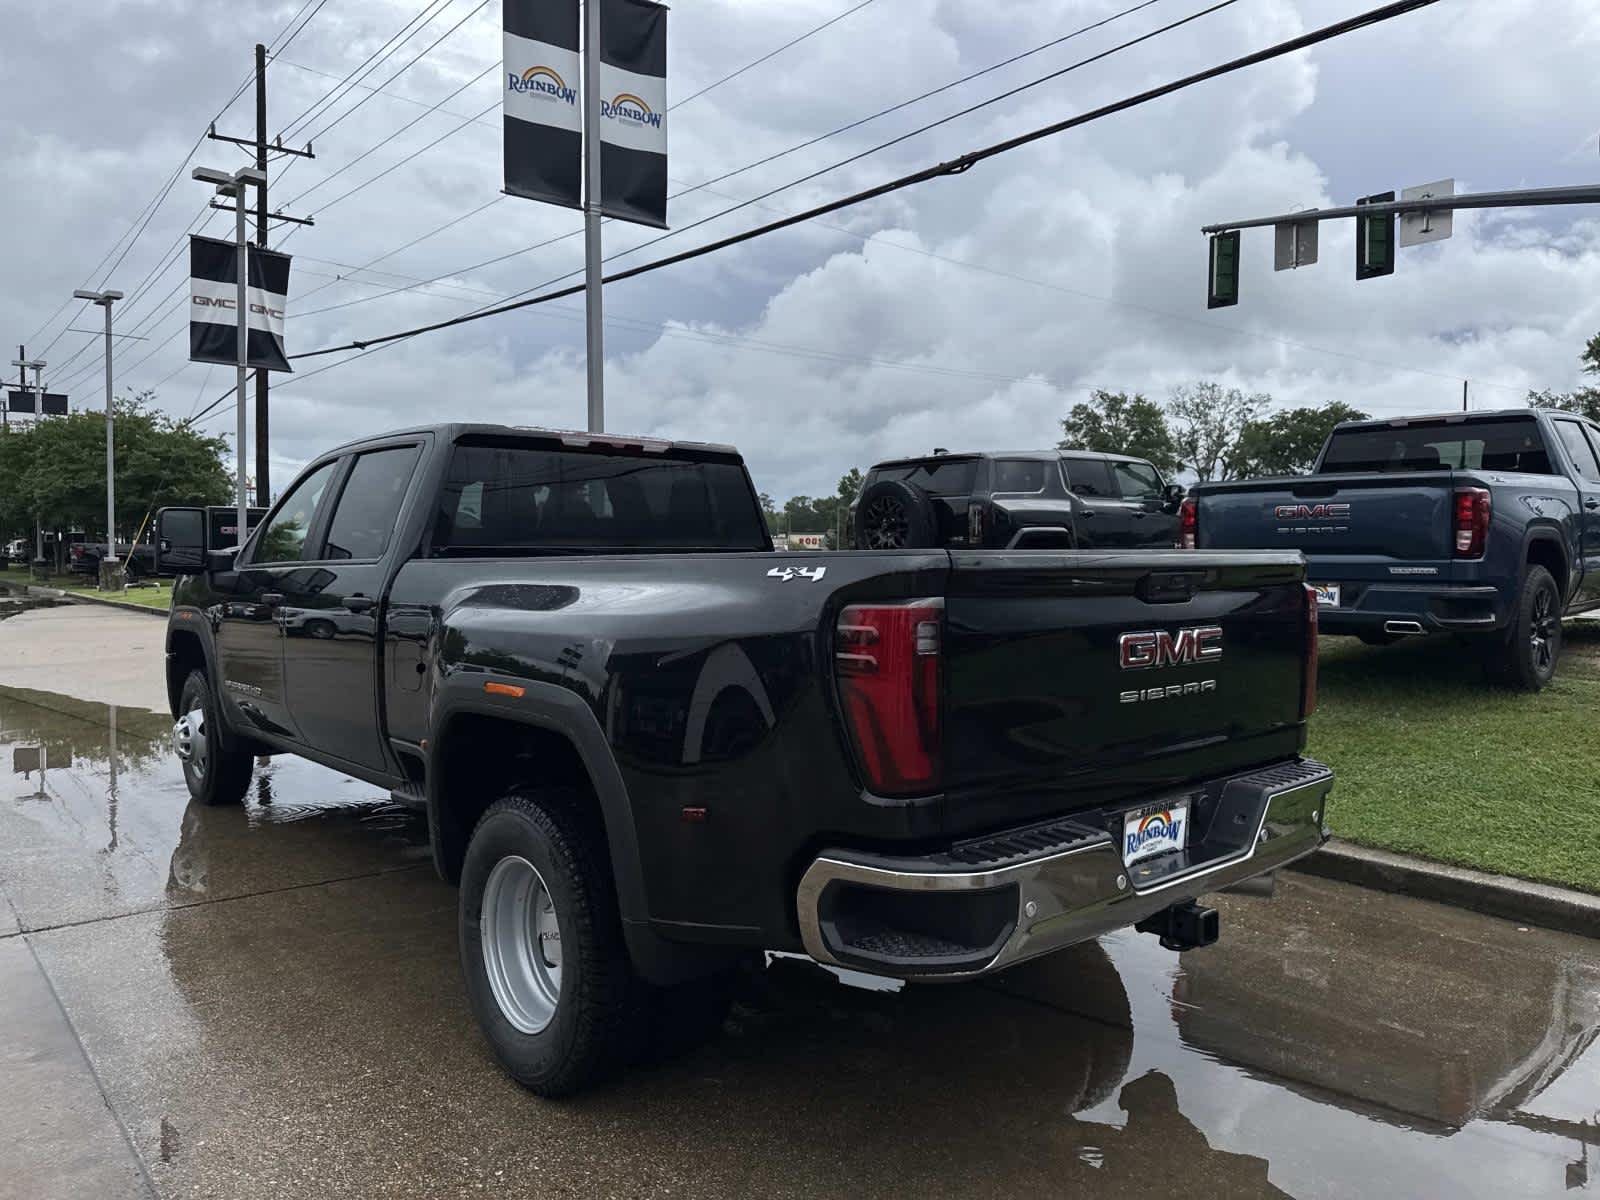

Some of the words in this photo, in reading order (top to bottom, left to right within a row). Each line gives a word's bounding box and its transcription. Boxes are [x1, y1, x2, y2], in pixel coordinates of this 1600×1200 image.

[508, 73, 576, 106] RAINBOW
[600, 100, 662, 128] RAINBOW
[193, 295, 236, 309] GMC
[249, 304, 284, 320] GMC
[1275, 504, 1350, 520] GMC
[1120, 627, 1222, 669] GMC
[1120, 679, 1216, 703] SIERRA
[1127, 819, 1182, 856] RAINBOW
